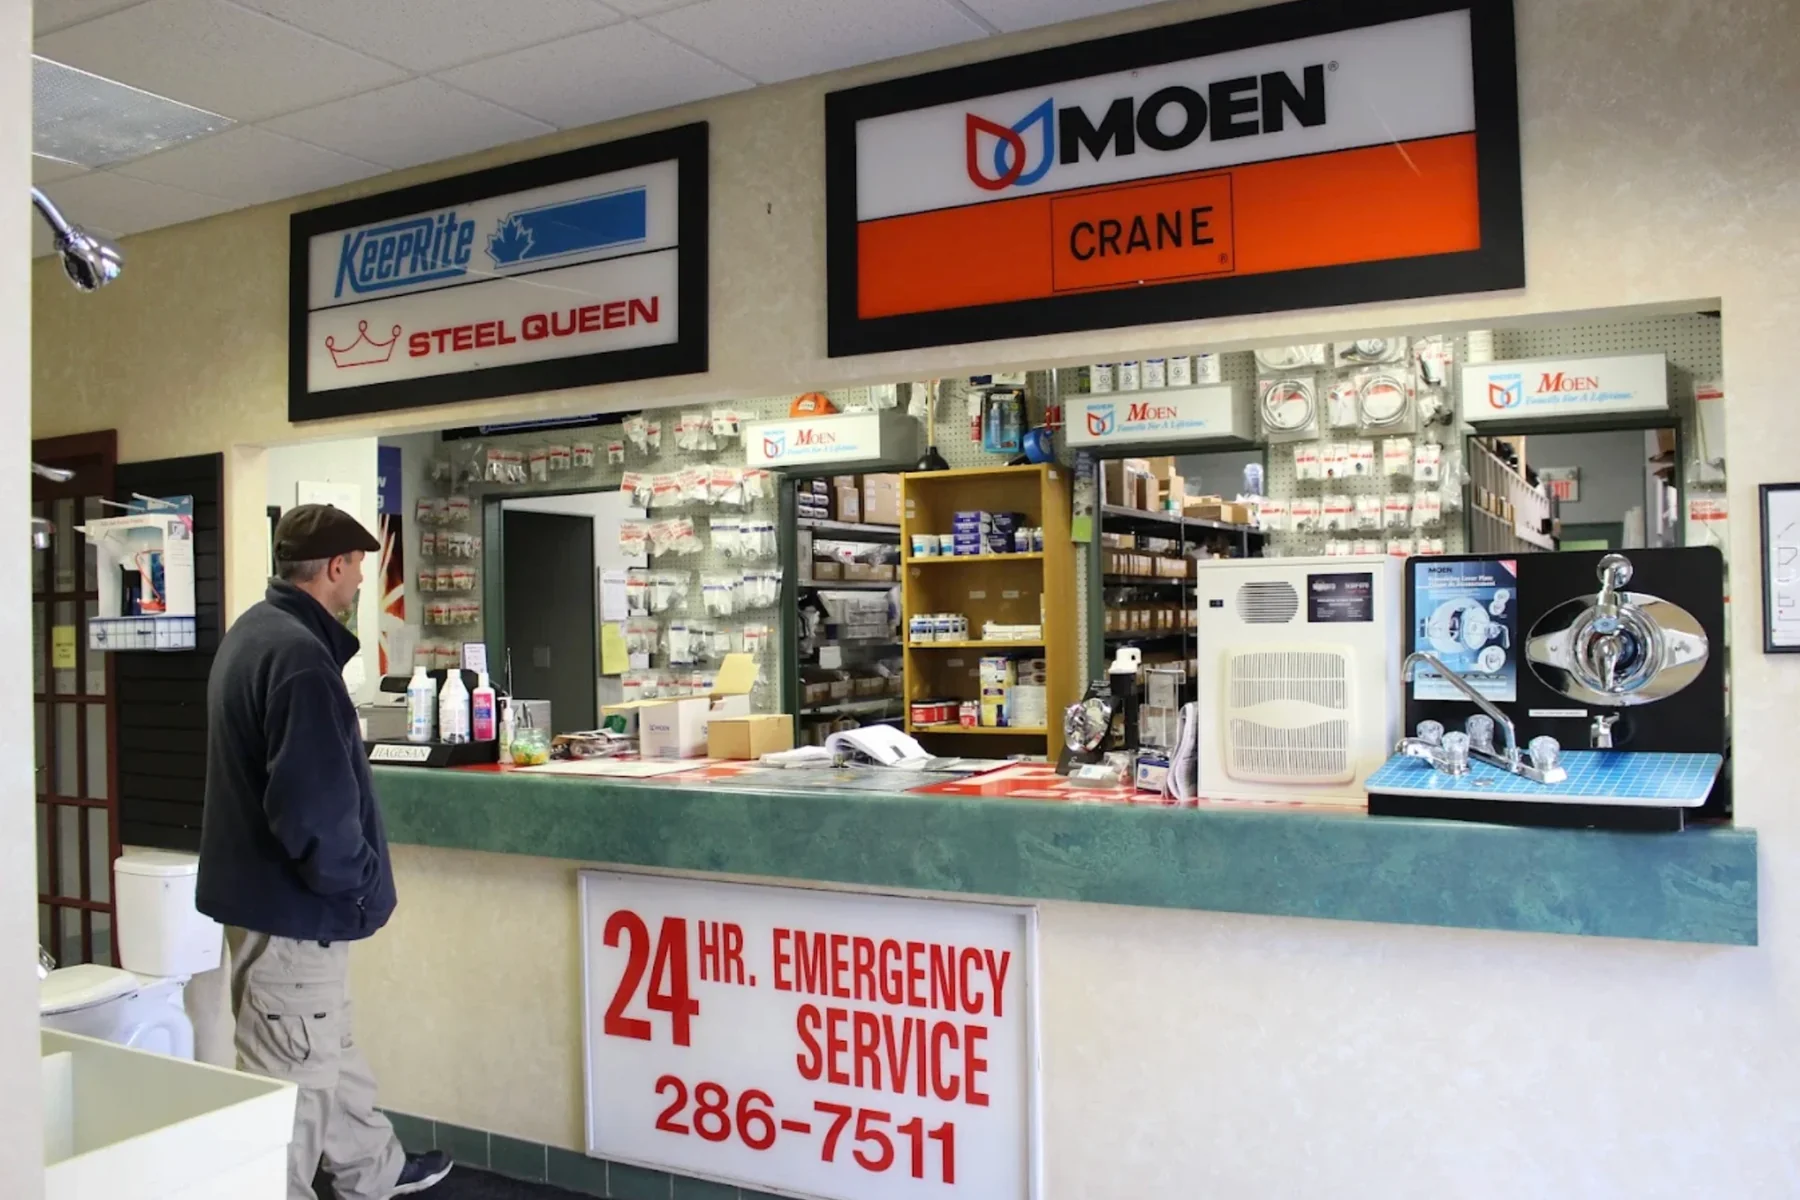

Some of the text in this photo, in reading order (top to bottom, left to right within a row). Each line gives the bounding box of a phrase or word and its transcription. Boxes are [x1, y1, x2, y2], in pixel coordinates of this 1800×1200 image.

[1059, 63, 1326, 165] MOEN
[1069, 205, 1215, 262] CRANE
[408, 296, 660, 358] STEEL QUEEN
[602, 909, 1012, 1047] 24 HR. EMERGENCY
[795, 1002, 990, 1107] SERVICE
[654, 1074, 956, 1185] 286-7511
